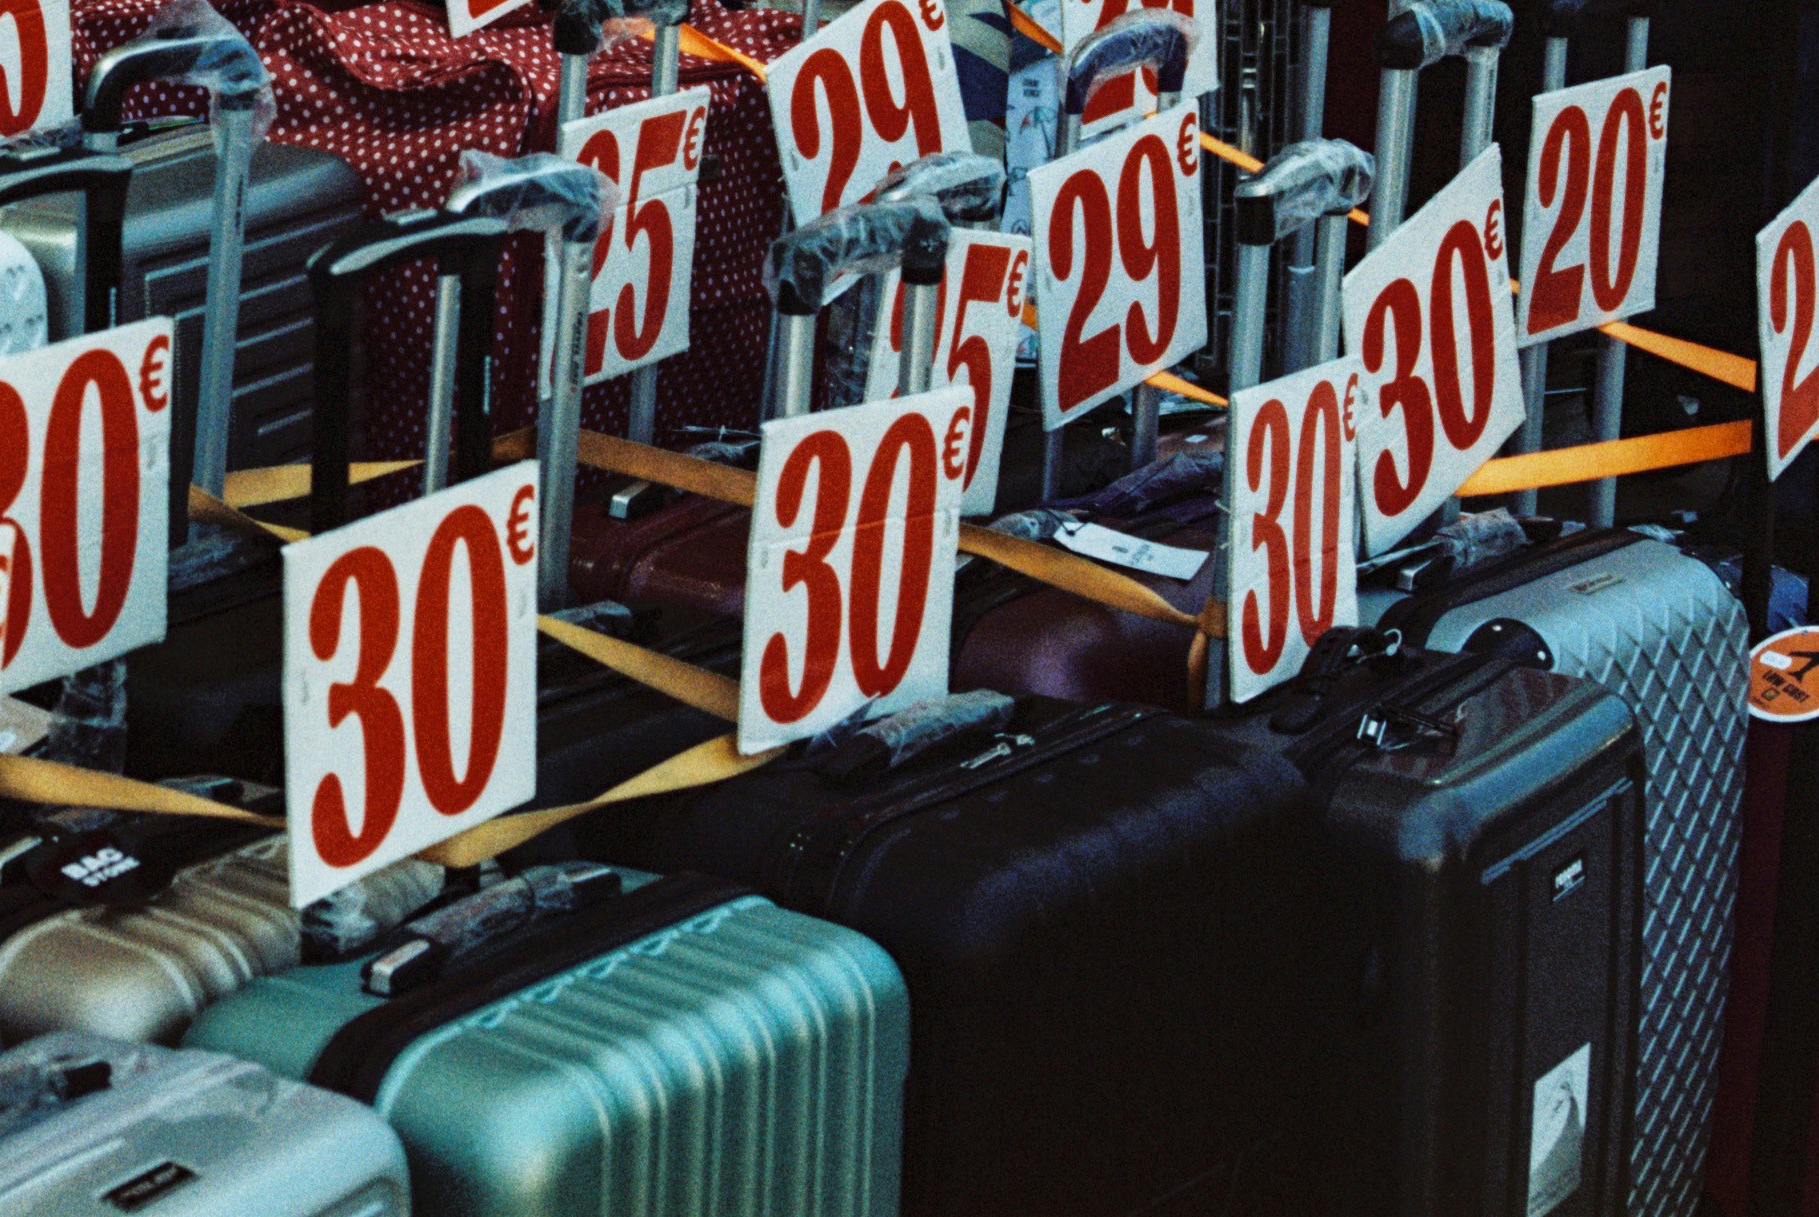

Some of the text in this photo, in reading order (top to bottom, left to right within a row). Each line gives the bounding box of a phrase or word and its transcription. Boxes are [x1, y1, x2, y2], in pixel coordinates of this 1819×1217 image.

[1048, 112, 1198, 412] 29€
[1362, 199, 1504, 516] 30€
[1528, 81, 1667, 335] 20€
[759, 406, 970, 724] 30€
[1242, 373, 1359, 675] 30€
[309, 484, 535, 868] 30€
[61, 847, 123, 880] BAG
